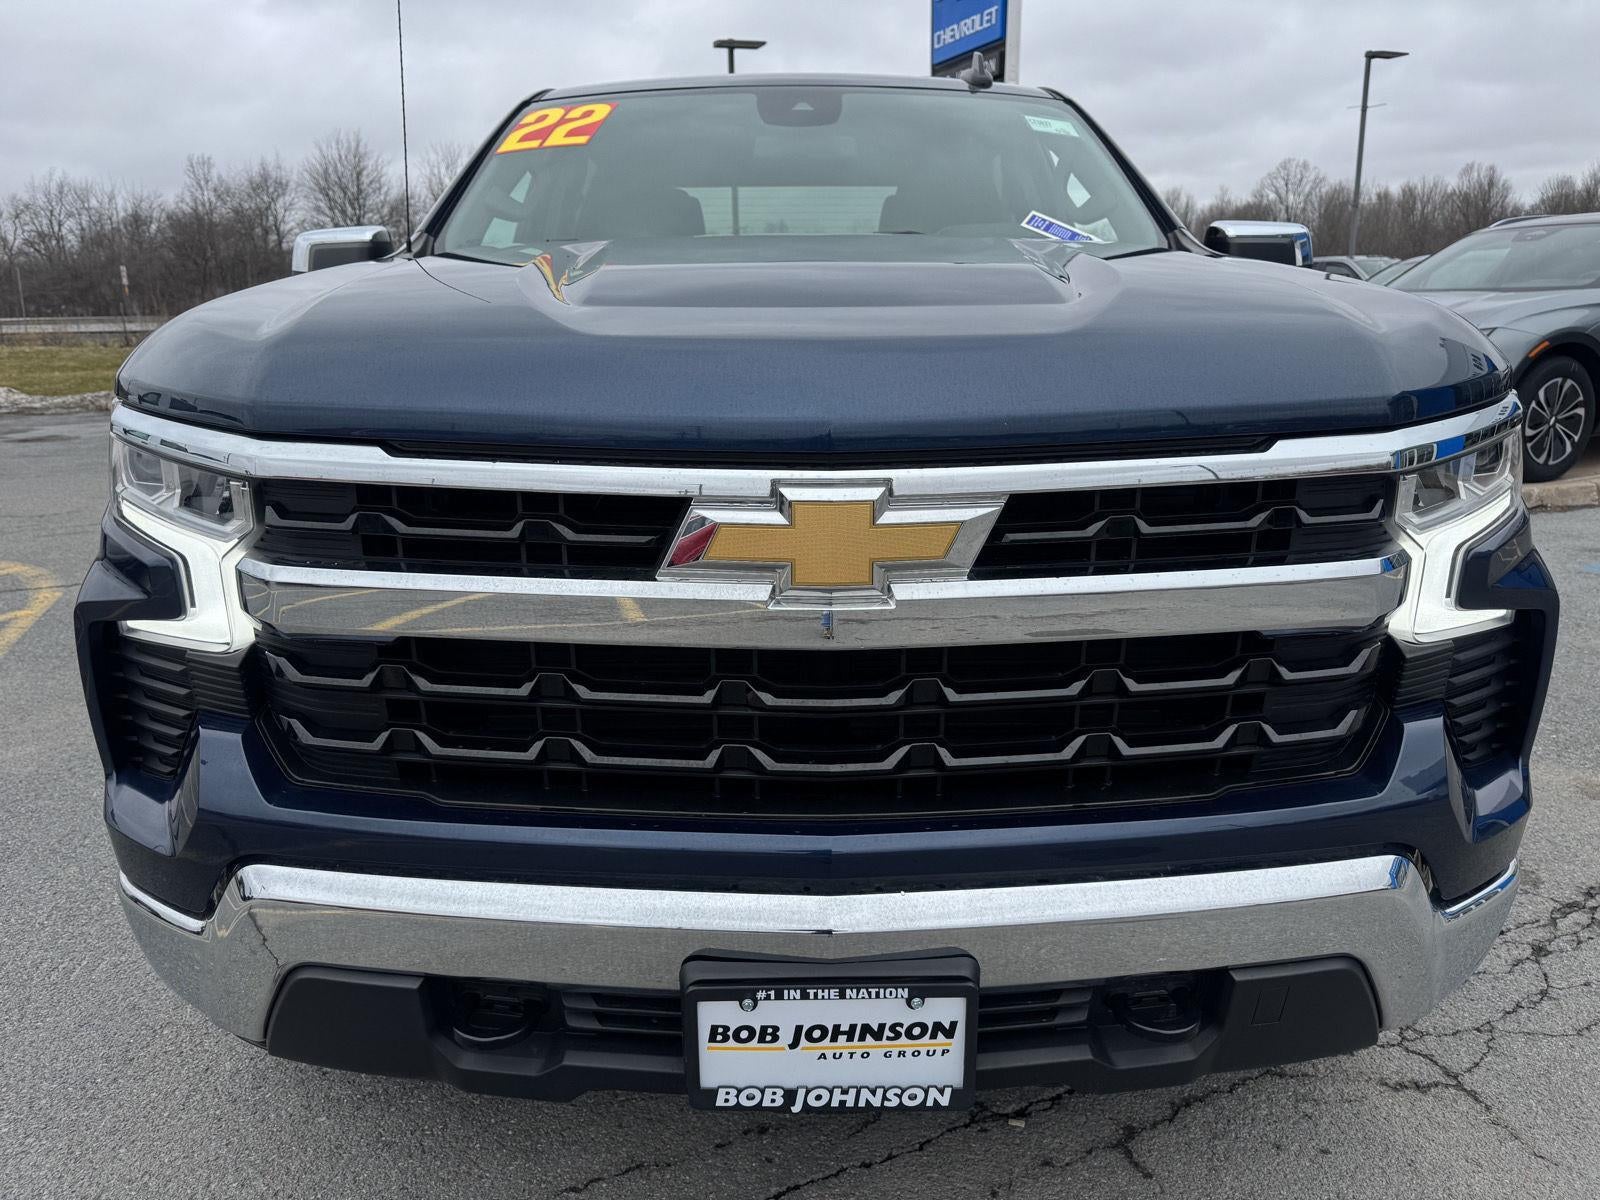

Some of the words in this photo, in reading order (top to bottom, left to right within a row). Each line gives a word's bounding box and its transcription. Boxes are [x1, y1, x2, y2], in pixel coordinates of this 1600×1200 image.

[934, 5, 998, 49] CHEVROLET
[496, 103, 612, 154] 22
[756, 990, 775, 1000] #1
[783, 989, 800, 1000] IN
[807, 989, 840, 1000] THE
[846, 988, 909, 999] NATION
[708, 1024, 780, 1044] BOB
[788, 1020, 958, 1050] JOHNSON
[817, 1052, 870, 1060] AUTO
[883, 1049, 950, 1059] GROUP
[715, 1087, 785, 1107] BOB
[791, 1086, 953, 1113] JOHNSON
